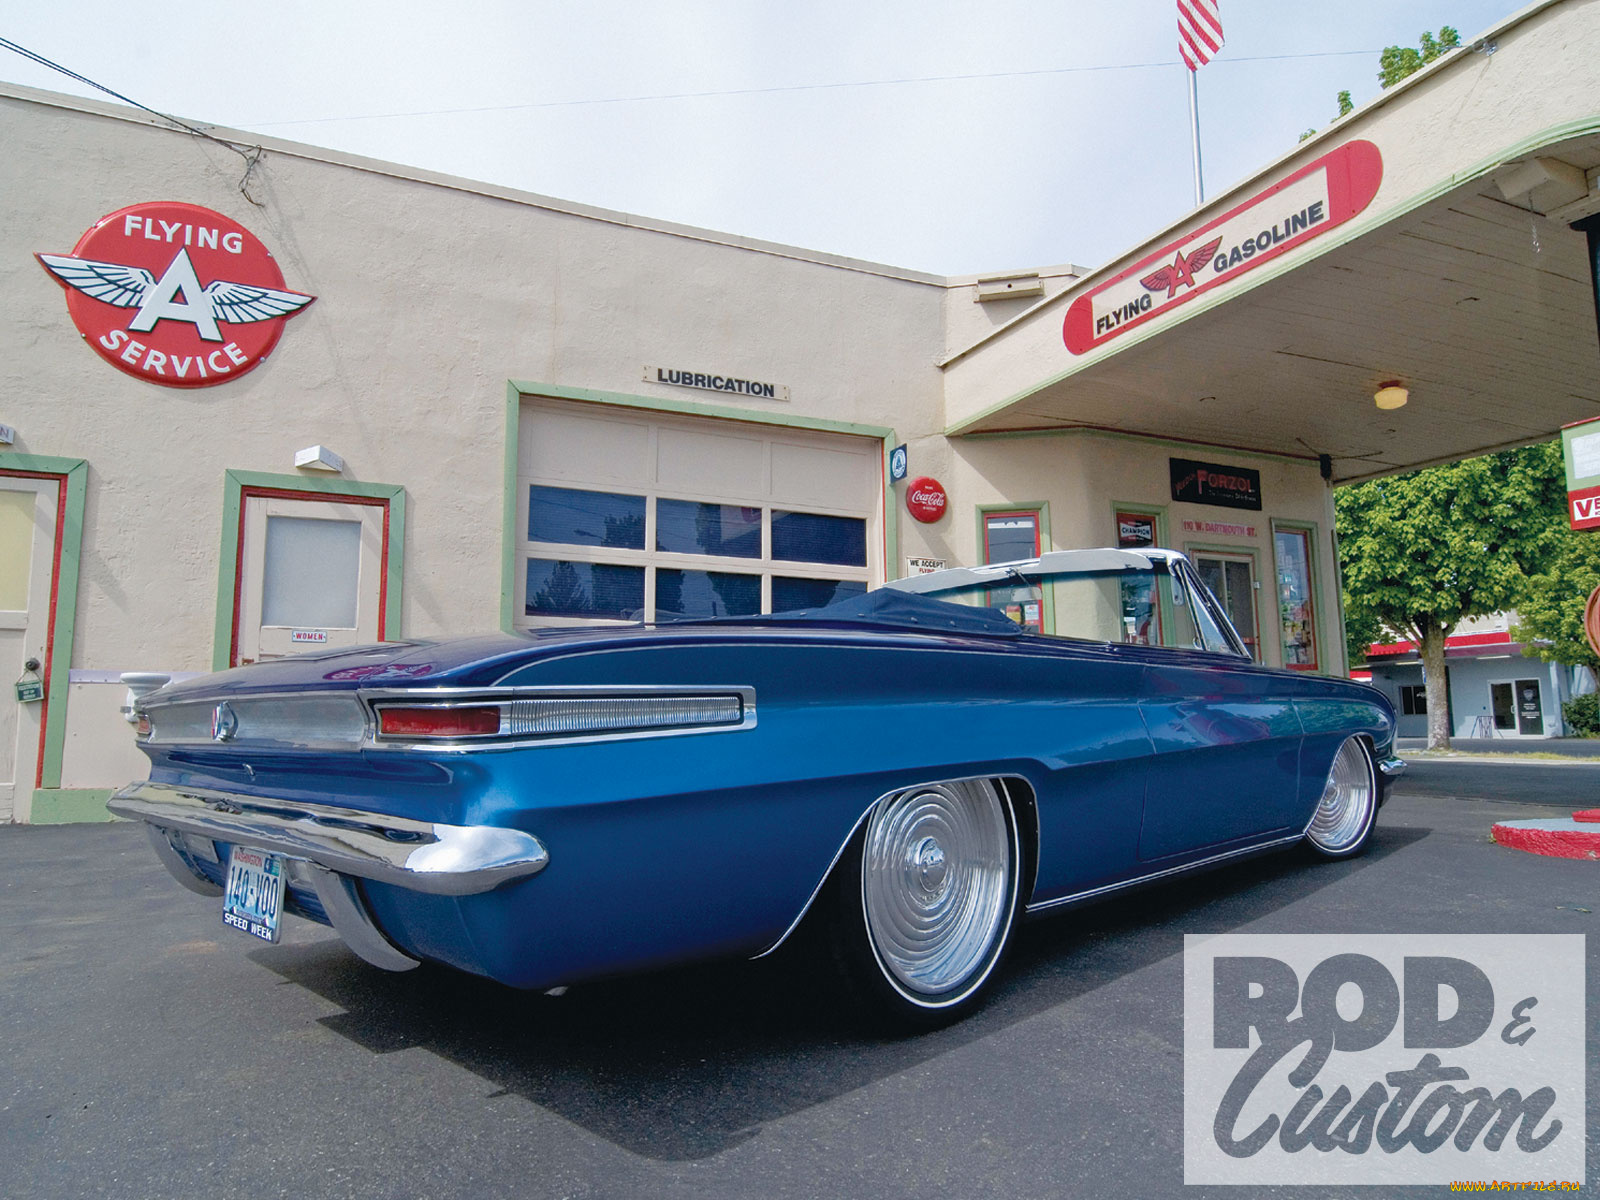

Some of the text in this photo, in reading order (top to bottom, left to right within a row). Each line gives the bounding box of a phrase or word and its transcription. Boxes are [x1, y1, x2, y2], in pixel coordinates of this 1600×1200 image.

[124, 214, 243, 254] FLYING
[1096, 294, 1153, 335] FLYING
[1212, 200, 1324, 273] GASOLINE
[127, 245, 225, 343] A
[99, 329, 248, 378] SERVICE
[657, 367, 775, 398] LUBRICATION
[912, 490, 944, 506] Coca-Cola
[1121, 527, 1150, 535] CHAMPION
[1205, 523, 1245, 535] DARTMOUTH
[921, 560, 943, 568] ACCEPT
[296, 632, 323, 640] WOMEN
[224, 913, 248, 930] SPEED
[251, 922, 273, 941] WEEK
